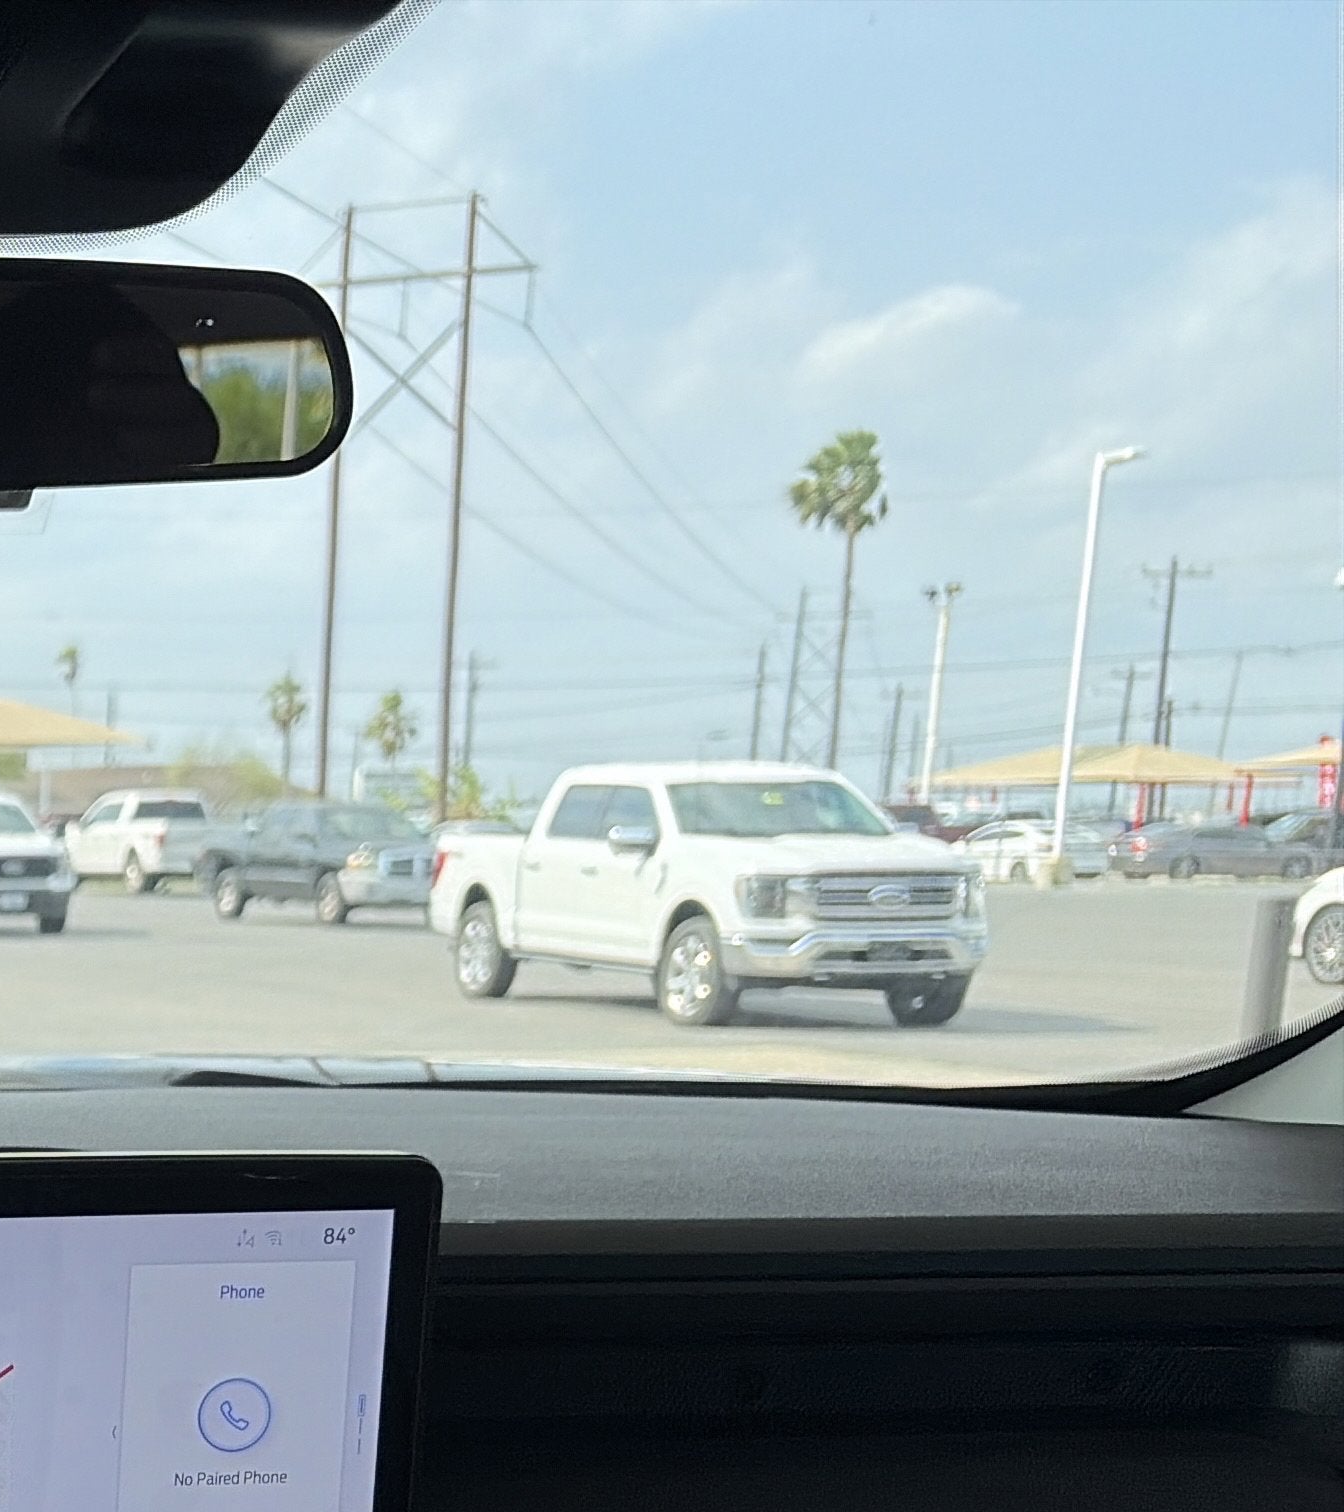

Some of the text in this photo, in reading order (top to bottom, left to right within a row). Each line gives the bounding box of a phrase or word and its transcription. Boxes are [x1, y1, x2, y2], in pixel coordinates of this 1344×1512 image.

[322, 1226, 357, 1245] 84°
[219, 1284, 266, 1299] Phone
[173, 1469, 289, 1487] No Paired Phone
